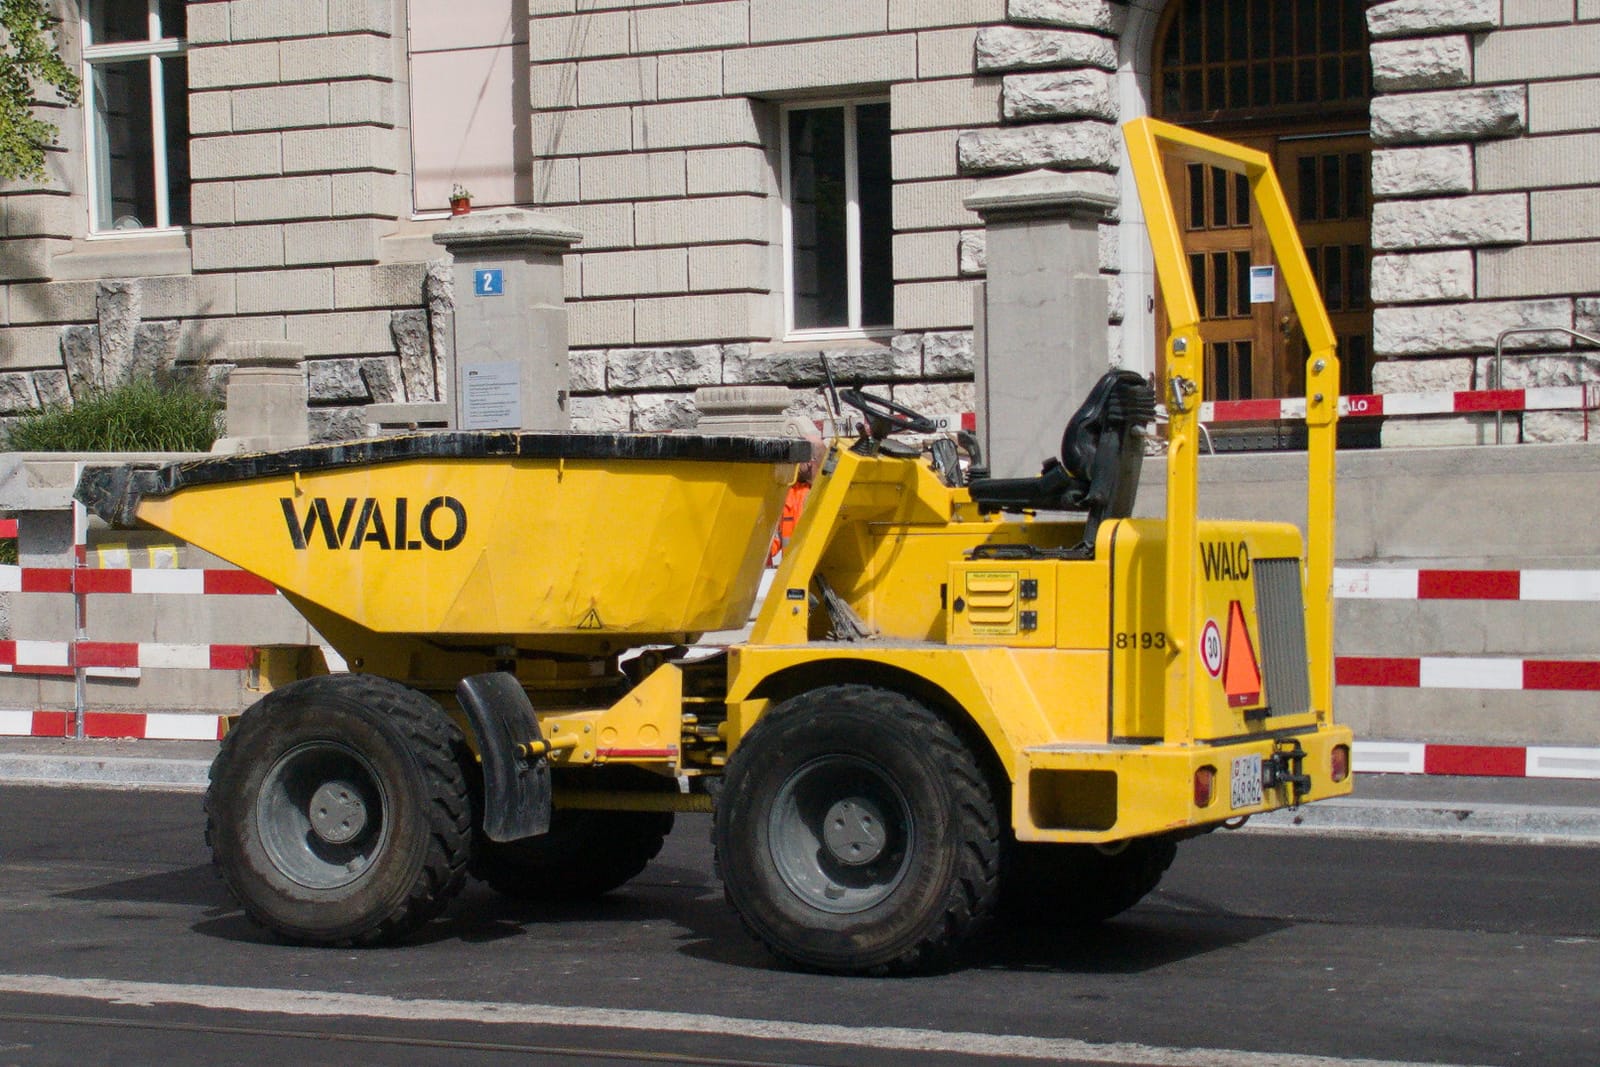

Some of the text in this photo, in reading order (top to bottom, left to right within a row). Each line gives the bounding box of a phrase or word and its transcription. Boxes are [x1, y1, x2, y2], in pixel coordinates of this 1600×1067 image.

[484, 273, 492, 291] 2
[280, 496, 467, 551] WALO
[1200, 541, 1249, 581] WALO
[1116, 632, 1166, 649] 8193
[1208, 636, 1218, 659] 30
